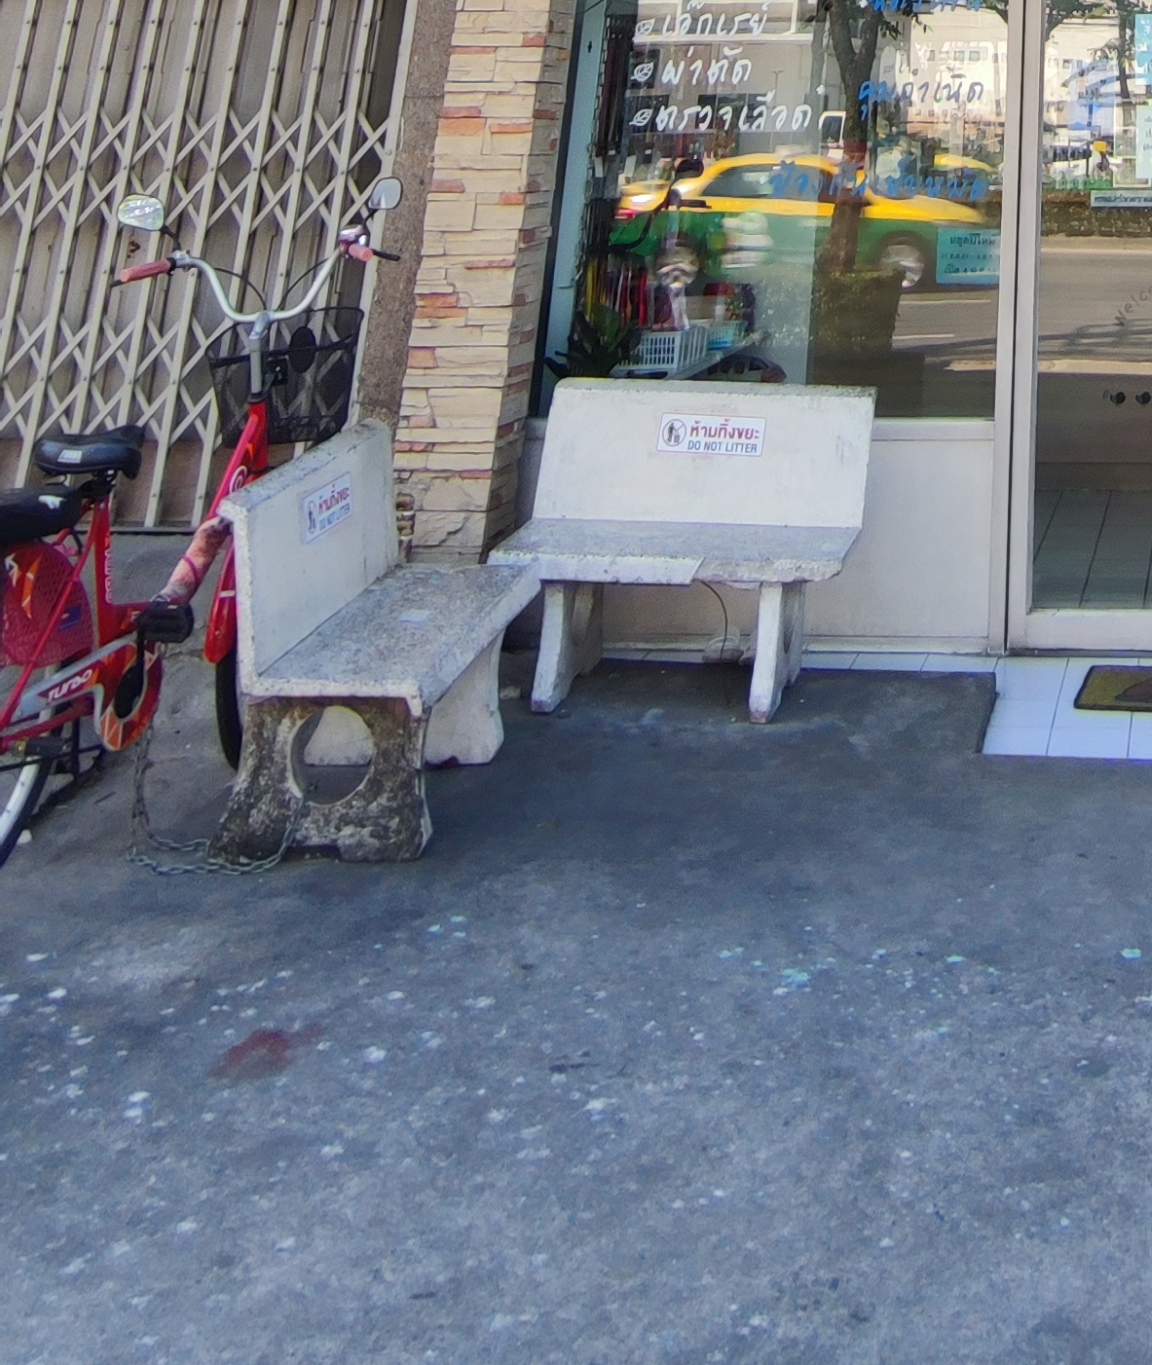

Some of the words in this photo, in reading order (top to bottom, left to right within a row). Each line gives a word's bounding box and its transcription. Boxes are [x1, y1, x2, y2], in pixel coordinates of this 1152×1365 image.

[661, 45, 752, 86] ผ่าตัด
[655, 89, 812, 132] ตรวจเลือด
[690, 418, 760, 441] ห้ามทิ้งขยะ
[687, 440, 701, 451] DO
[703, 441, 724, 452] NOT
[725, 442, 758, 454] LITTER
